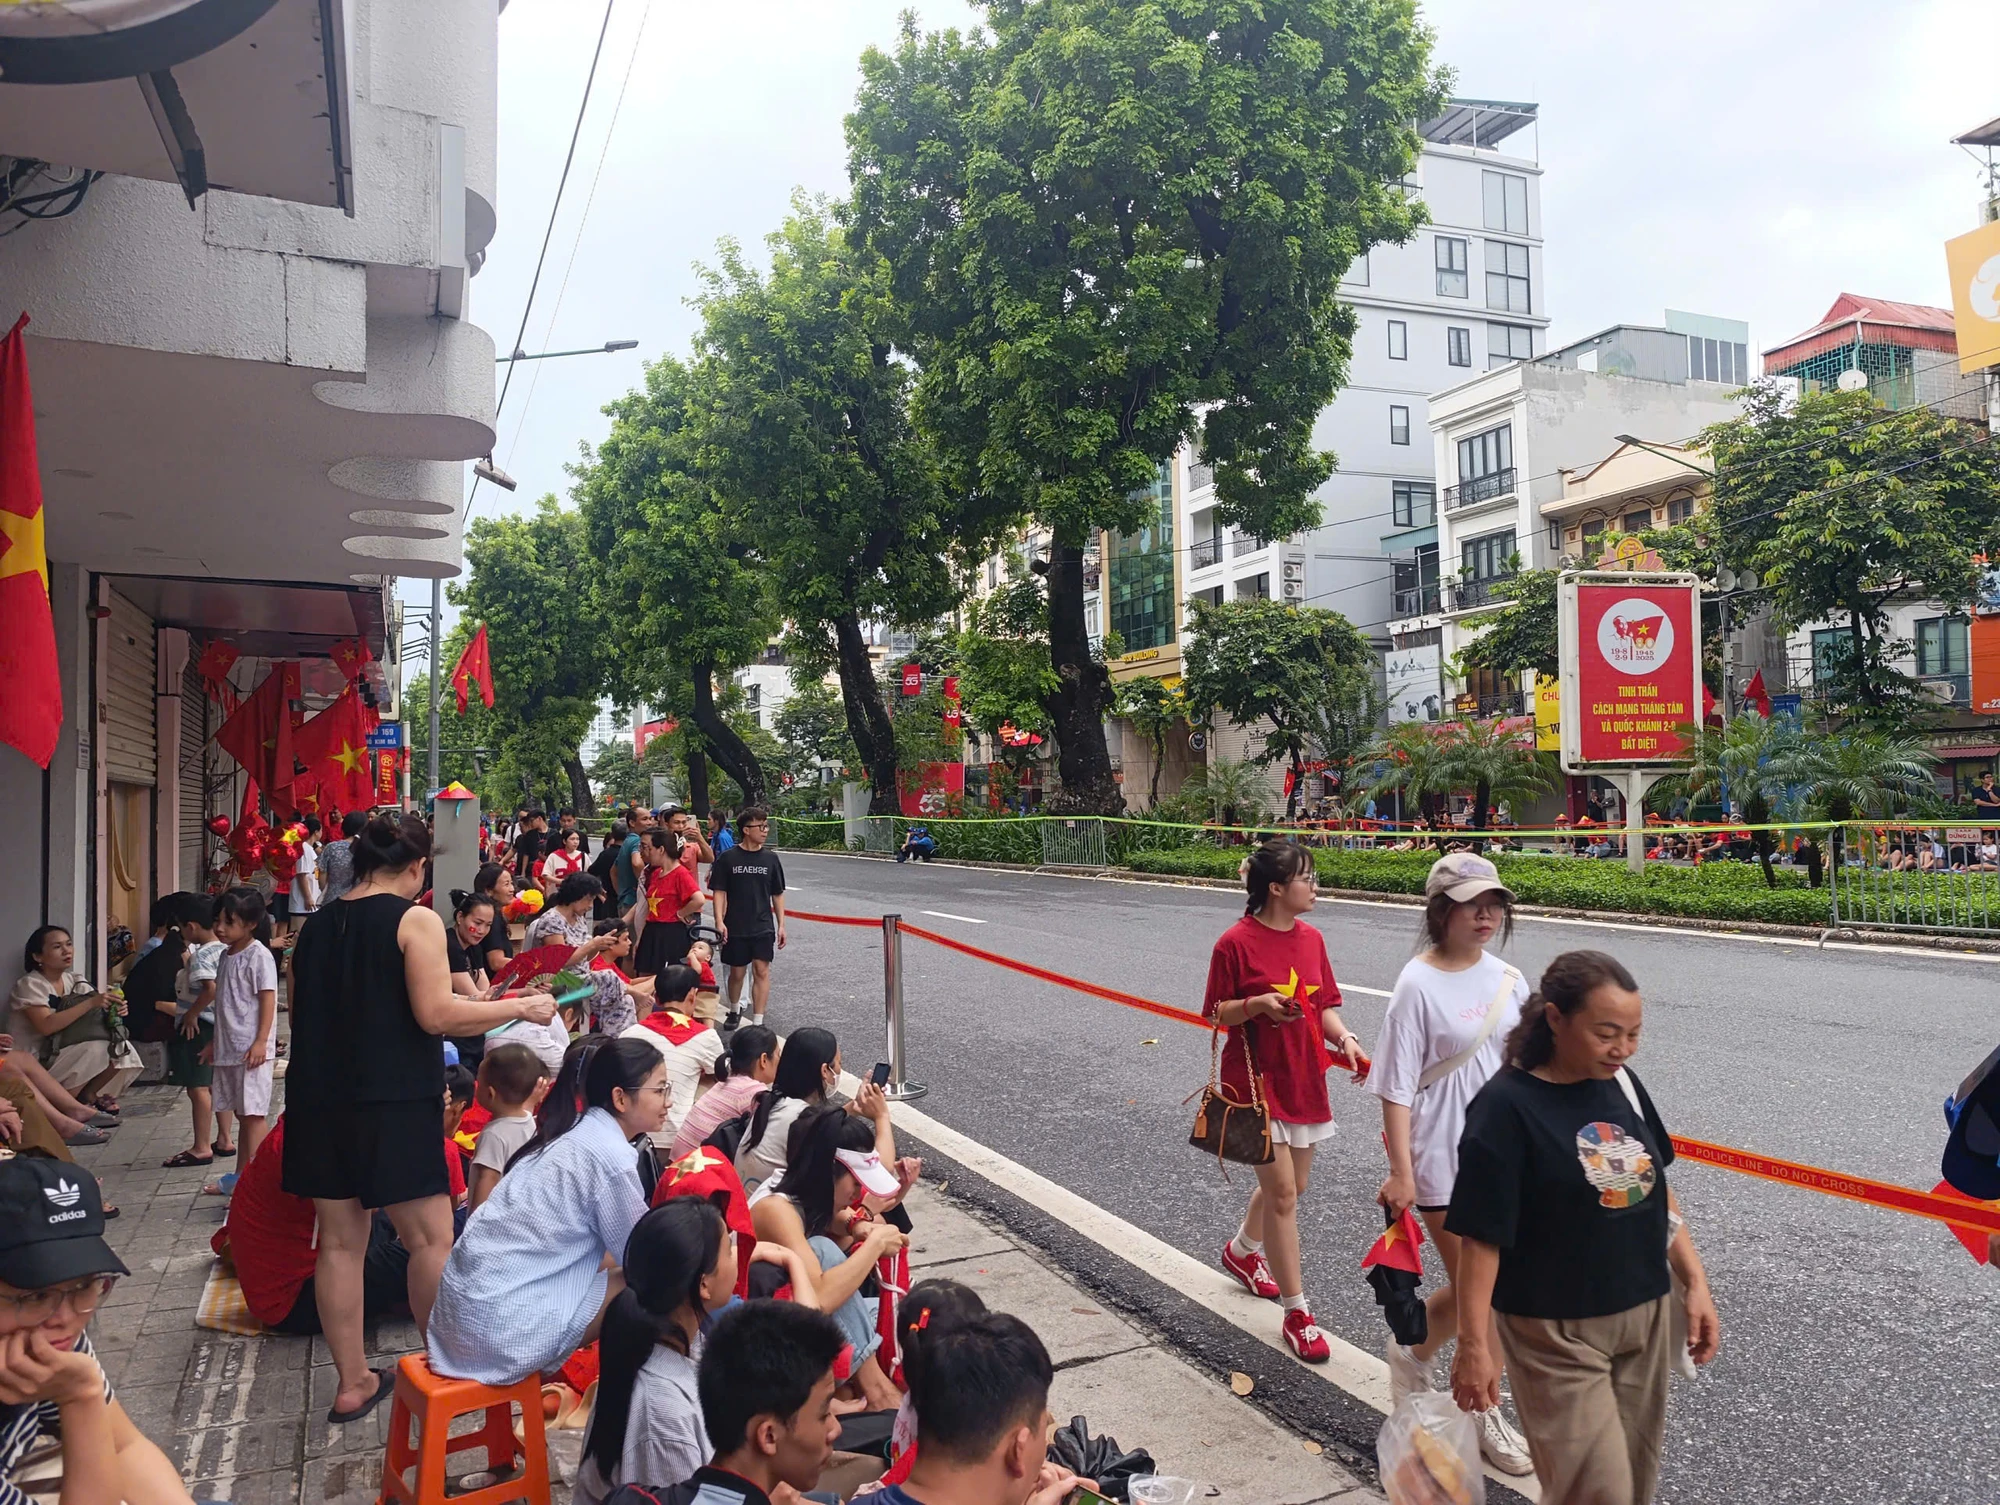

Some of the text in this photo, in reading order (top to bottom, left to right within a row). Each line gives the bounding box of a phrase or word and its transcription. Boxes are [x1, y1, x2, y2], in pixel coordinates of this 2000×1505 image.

[905, 676, 919, 686] 5G
[1618, 686, 1636, 697] TINH
[1593, 701, 1614, 715] CÁCH
[1615, 703, 1639, 717] MẠNG
[1640, 701, 1666, 715] THÁNG
[382, 728, 394, 736] 169
[1601, 719, 1612, 732] VÀ
[1613, 717, 1635, 733] QUỐC
[1636, 719, 1662, 732] KHÁNH
[1621, 735, 1636, 750] BẤT
[1672, 1141, 1687, 1153] UA
[1696, 1147, 1735, 1164] POLICE
[1738, 1157, 1764, 1172] LINE
[1771, 1165, 1788, 1178] DO
[1792, 1169, 1816, 1184] NOT
[1821, 1177, 1865, 1196] CROSS
[49, 1210, 87, 1224] adidas
